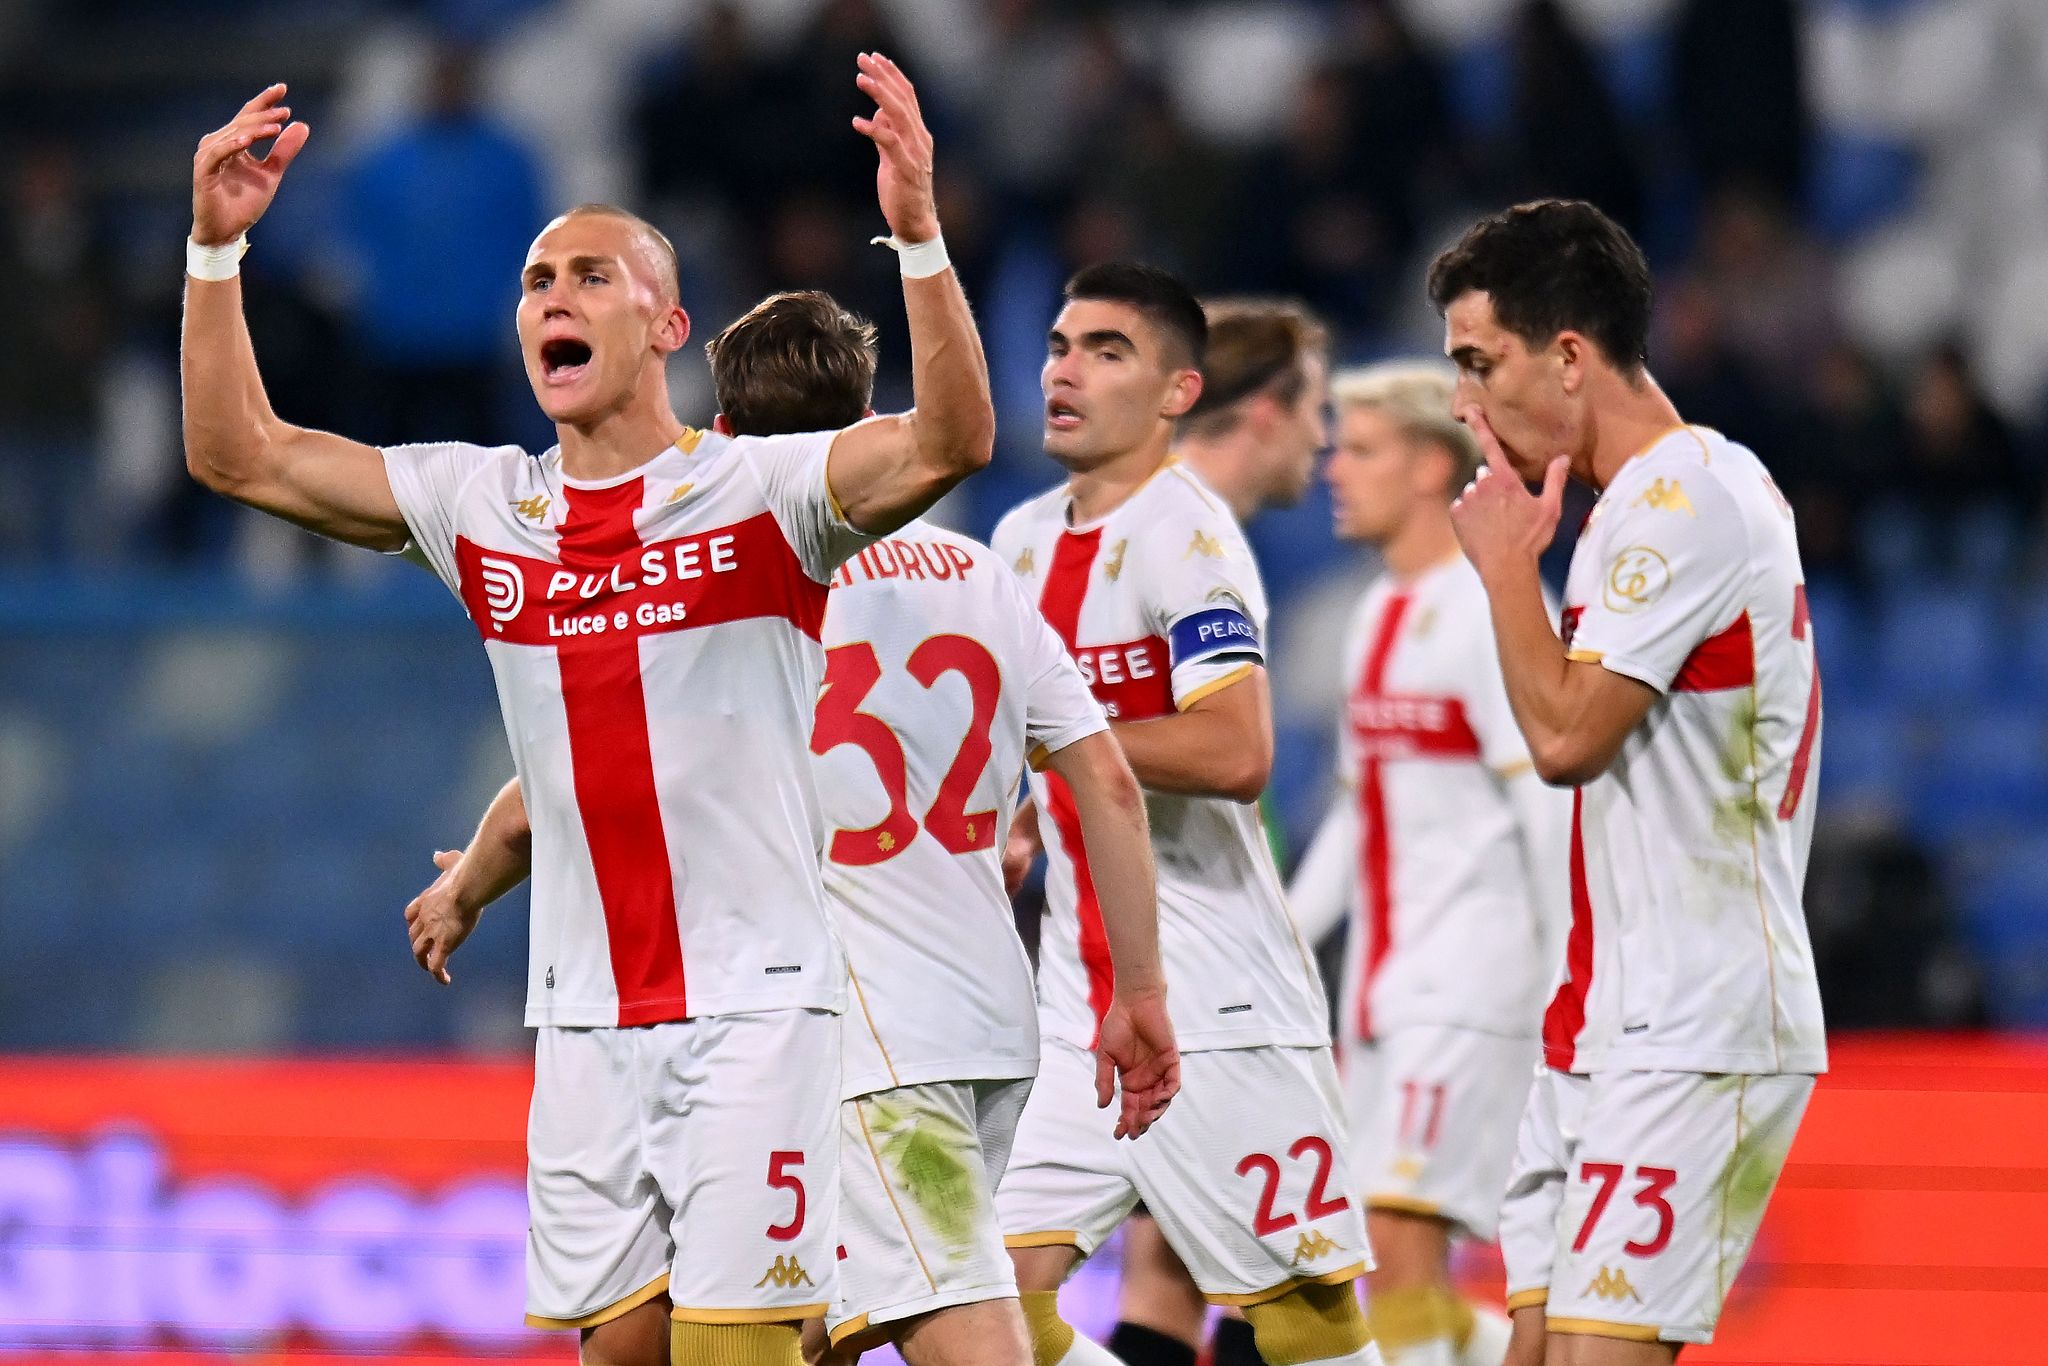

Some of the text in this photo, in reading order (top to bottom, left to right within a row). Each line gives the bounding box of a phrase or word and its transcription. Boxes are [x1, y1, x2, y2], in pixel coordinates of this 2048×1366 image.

[546, 534, 738, 600] PULSEE
[548, 601, 687, 638] Luce e Gas
[809, 633, 1002, 867] 32
[1399, 1080, 1446, 1148] 11
[765, 1150, 806, 1242] 5
[1234, 1135, 1350, 1238] 22
[1571, 1162, 1677, 1259] 73
